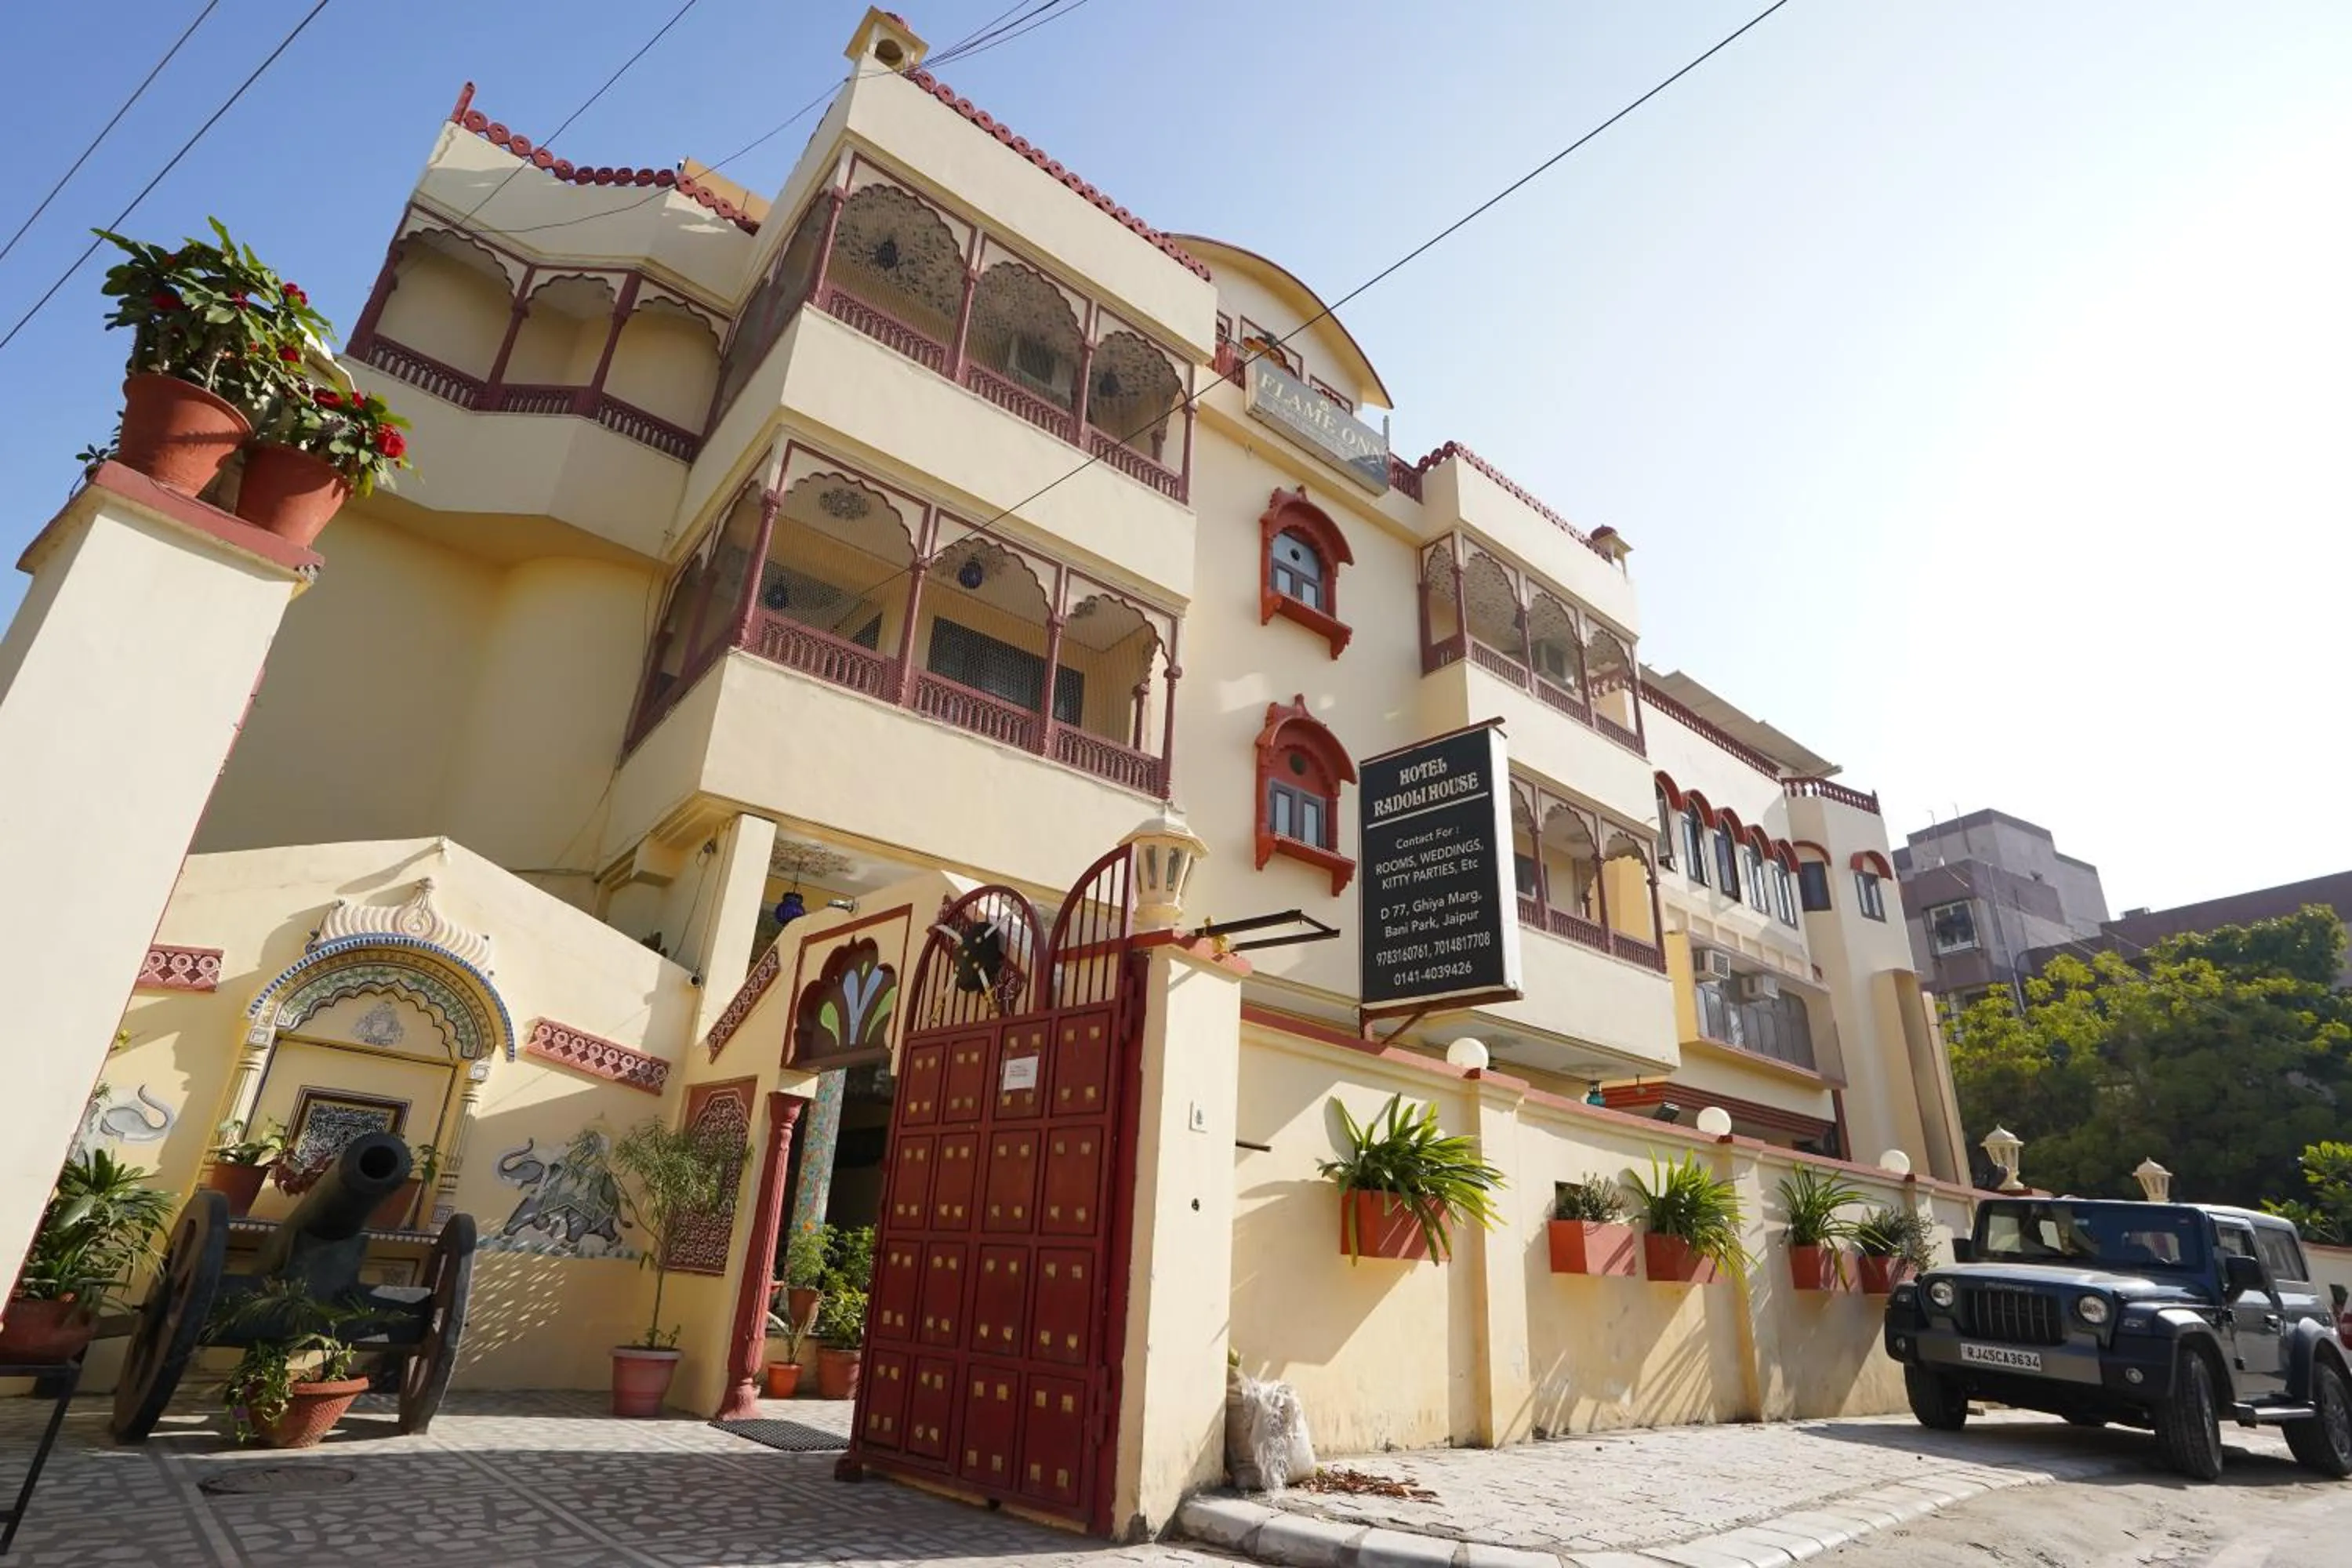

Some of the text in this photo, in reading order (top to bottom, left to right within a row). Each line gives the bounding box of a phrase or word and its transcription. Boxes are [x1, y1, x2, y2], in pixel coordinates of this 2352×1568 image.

[1399, 757, 1448, 786] HOTEL
[1374, 771, 1479, 816] RADOLI HOUSE
[1396, 832, 1434, 849] Contact
[1436, 827, 1454, 839] For
[1382, 873, 1410, 891] KITTY
[1461, 858, 1479, 872] Etc
[1381, 907, 1390, 920] D
[1392, 903, 1410, 918] 77,
[1413, 897, 1445, 913] Ghiya
[1385, 910, 1479, 938] Bani Park, Jaipur
[1393, 960, 1473, 986] 0141-4039426
